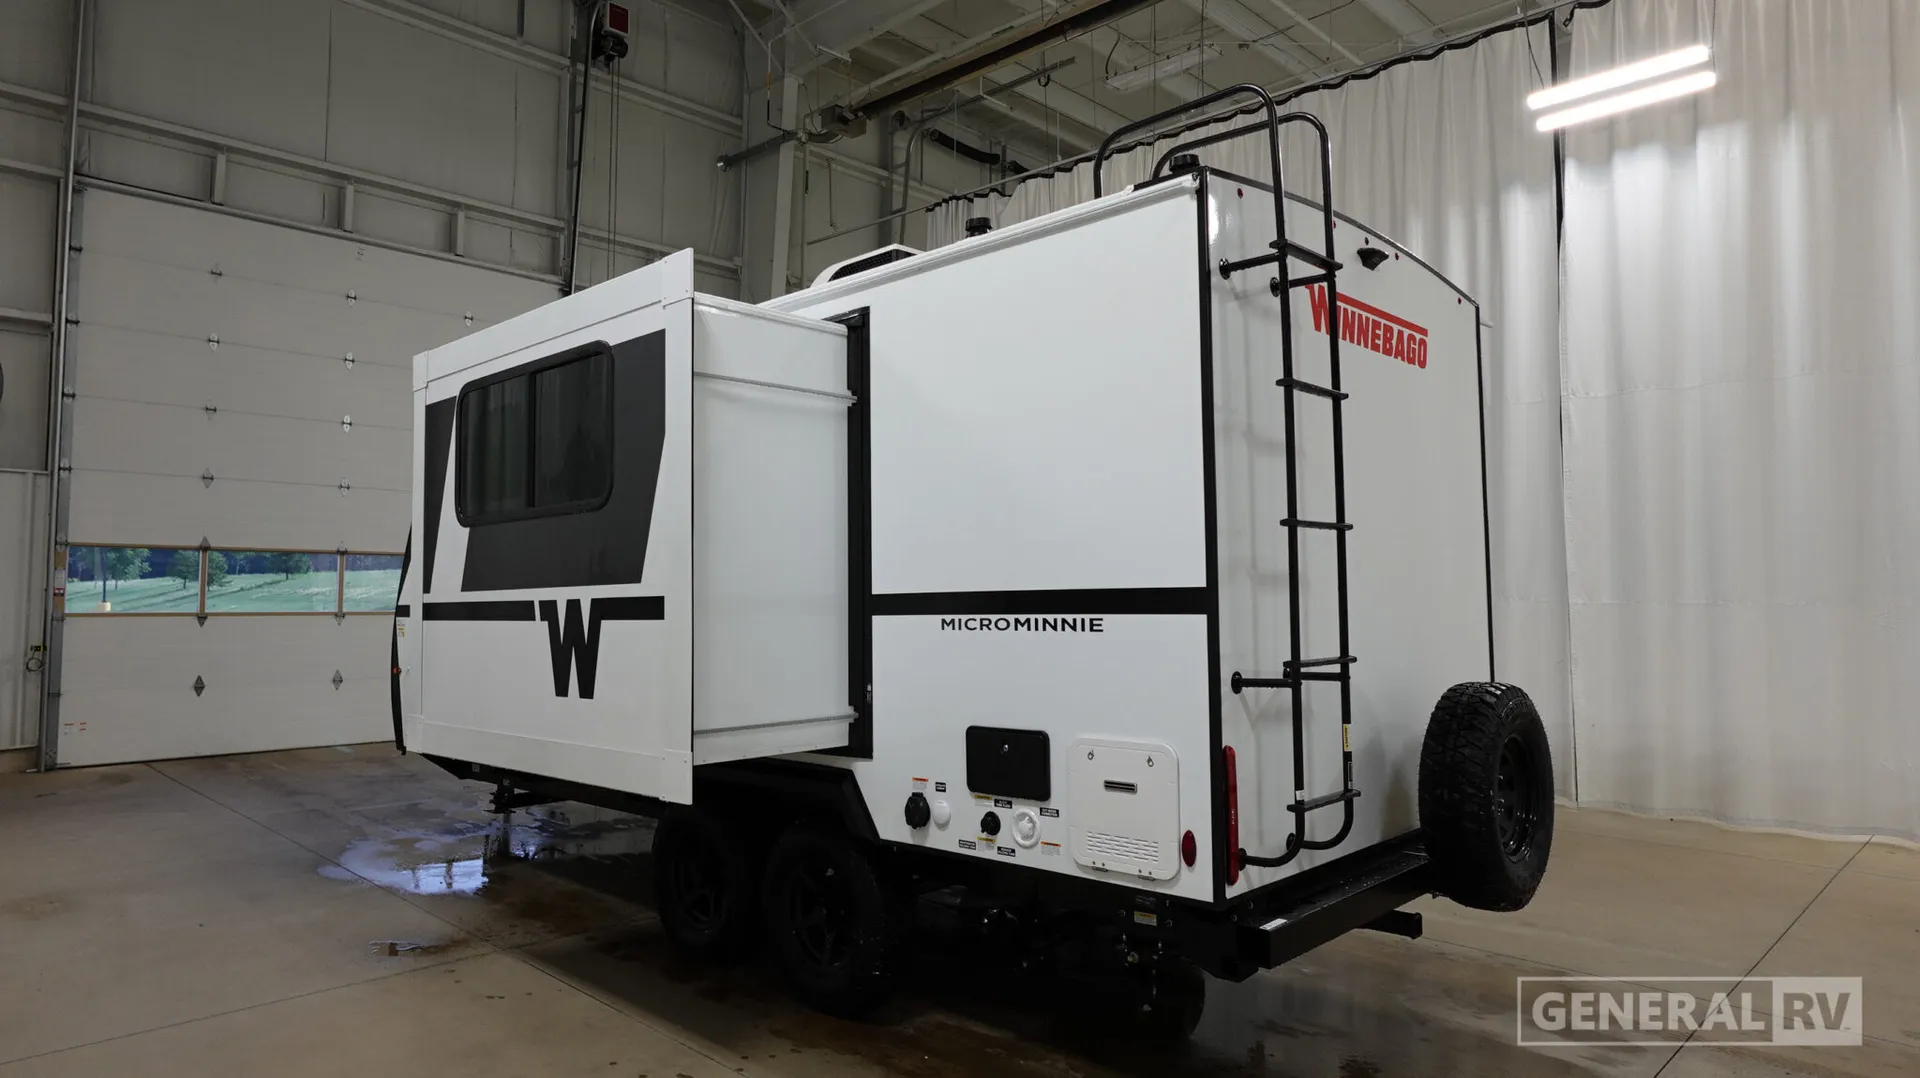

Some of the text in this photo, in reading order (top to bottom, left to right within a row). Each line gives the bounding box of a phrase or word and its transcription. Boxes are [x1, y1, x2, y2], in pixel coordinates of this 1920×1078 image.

[1305, 284, 1428, 369] WINNEBAGO
[539, 598, 602, 699] W
[941, 617, 1104, 632] MICROMINNIE
